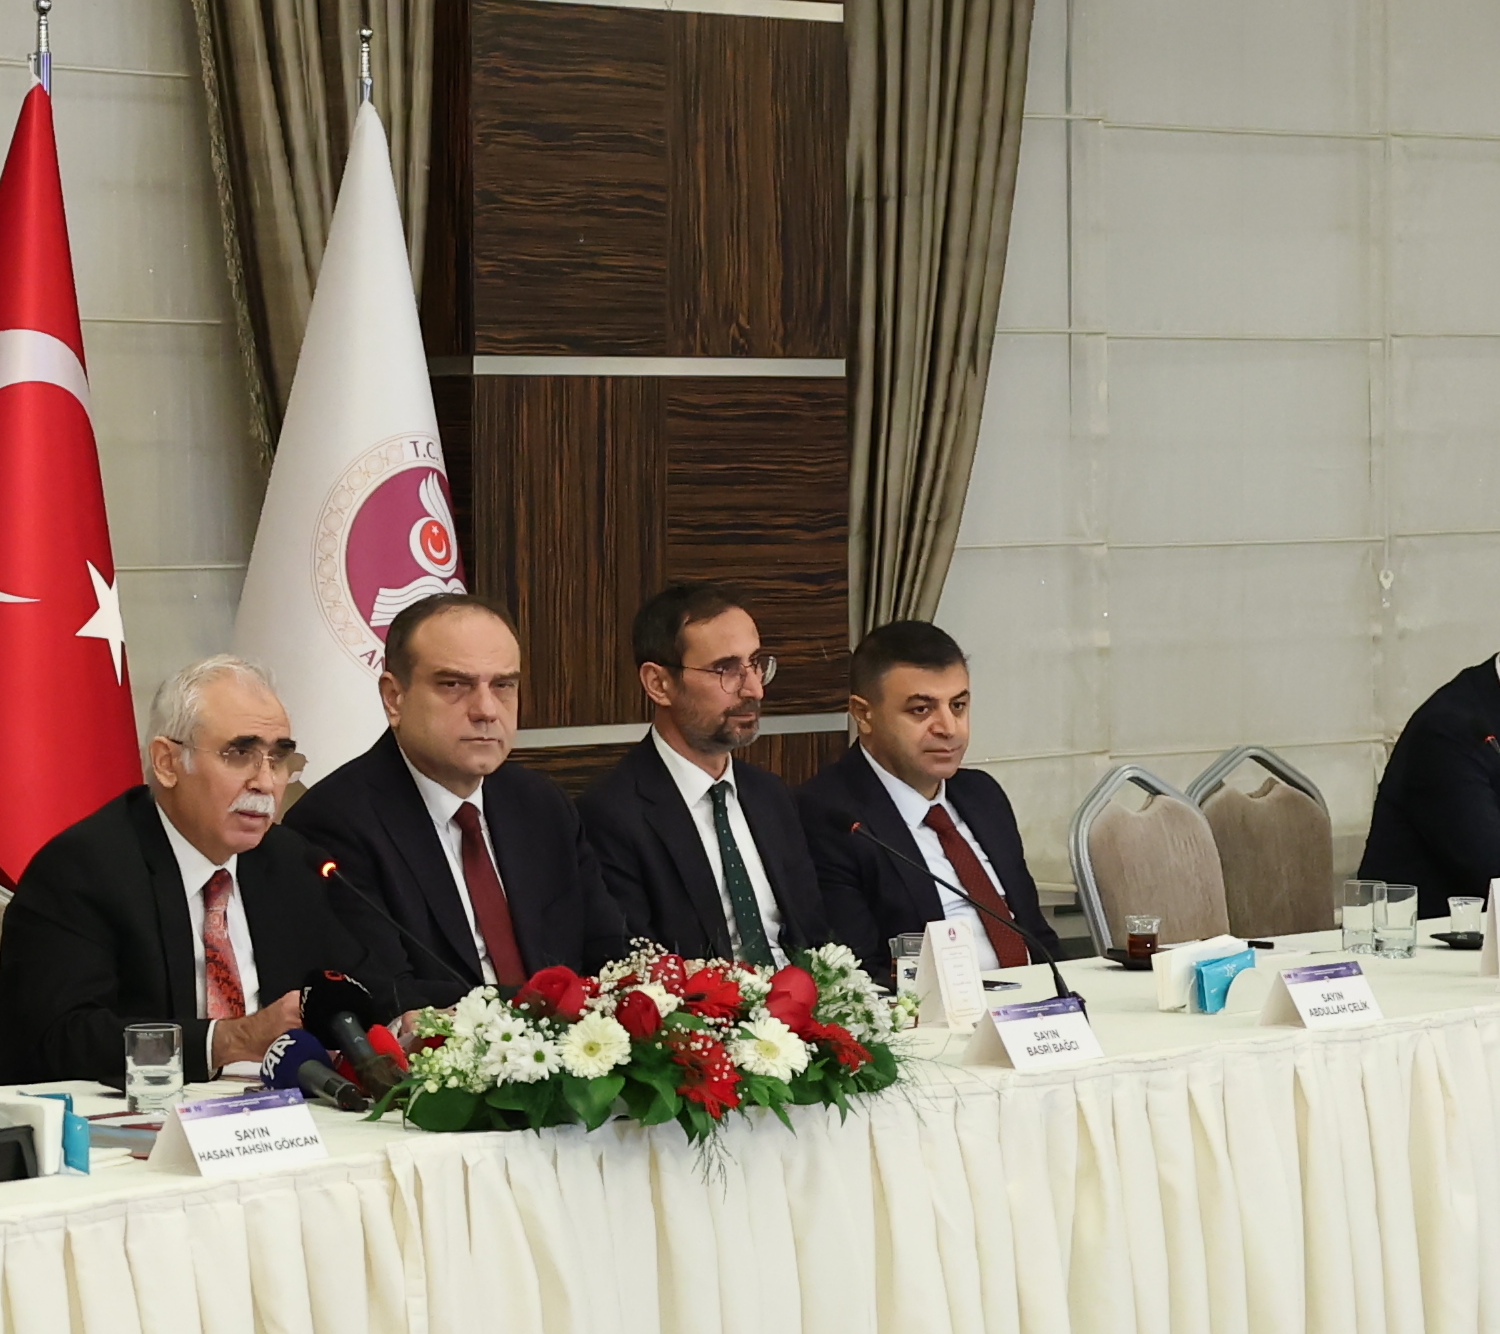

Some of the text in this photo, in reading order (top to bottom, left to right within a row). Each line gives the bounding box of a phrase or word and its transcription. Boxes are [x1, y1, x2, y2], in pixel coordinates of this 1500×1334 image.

[1309, 1004, 1348, 1017] ABDULLAH
[1033, 1029, 1060, 1041] SAYIN
[234, 1126, 271, 1142] SAYIN
[198, 1147, 235, 1162] HASAN
[235, 1140, 273, 1157] TAHSİN
